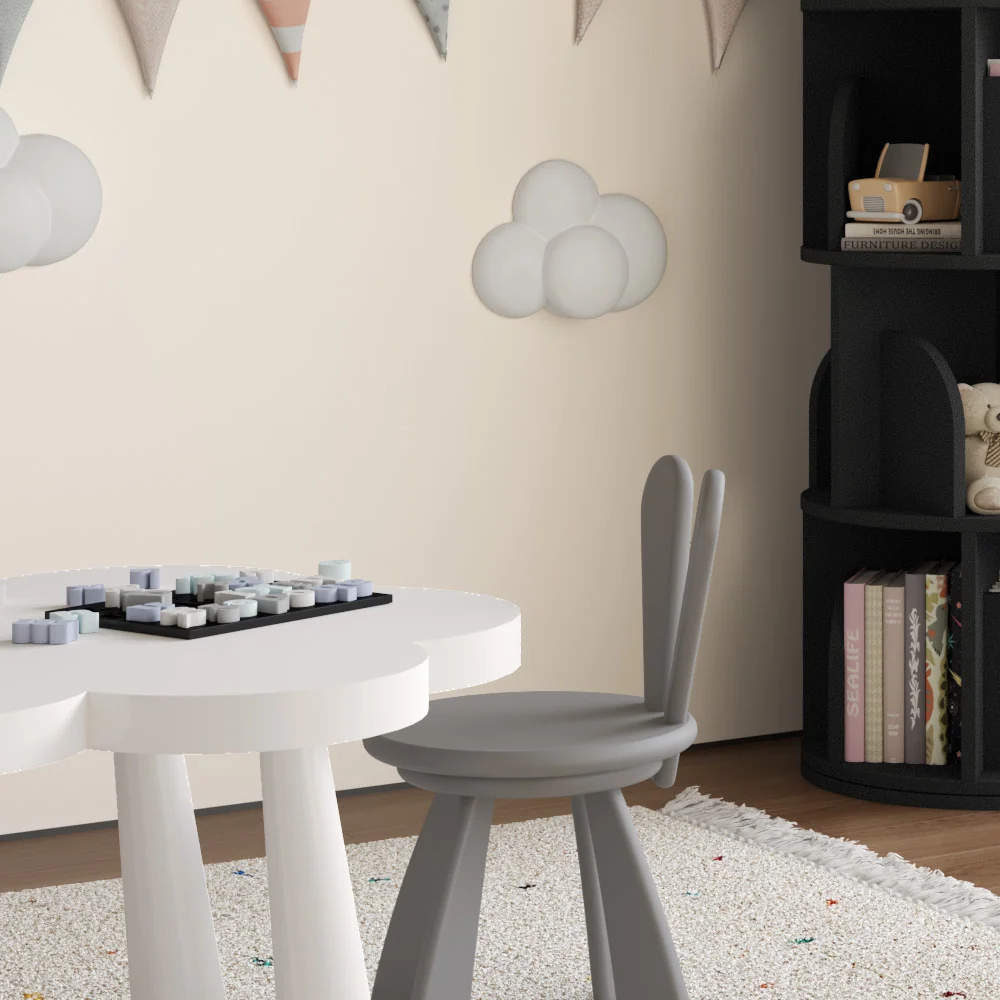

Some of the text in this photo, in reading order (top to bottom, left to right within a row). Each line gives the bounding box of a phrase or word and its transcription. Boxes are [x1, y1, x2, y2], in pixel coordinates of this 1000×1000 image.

[873, 228, 941, 236] BRINGING THE HOUSE HOME
[844, 240, 962, 250] FURNITURE DESIG
[847, 628, 860, 717] SEALIFE
